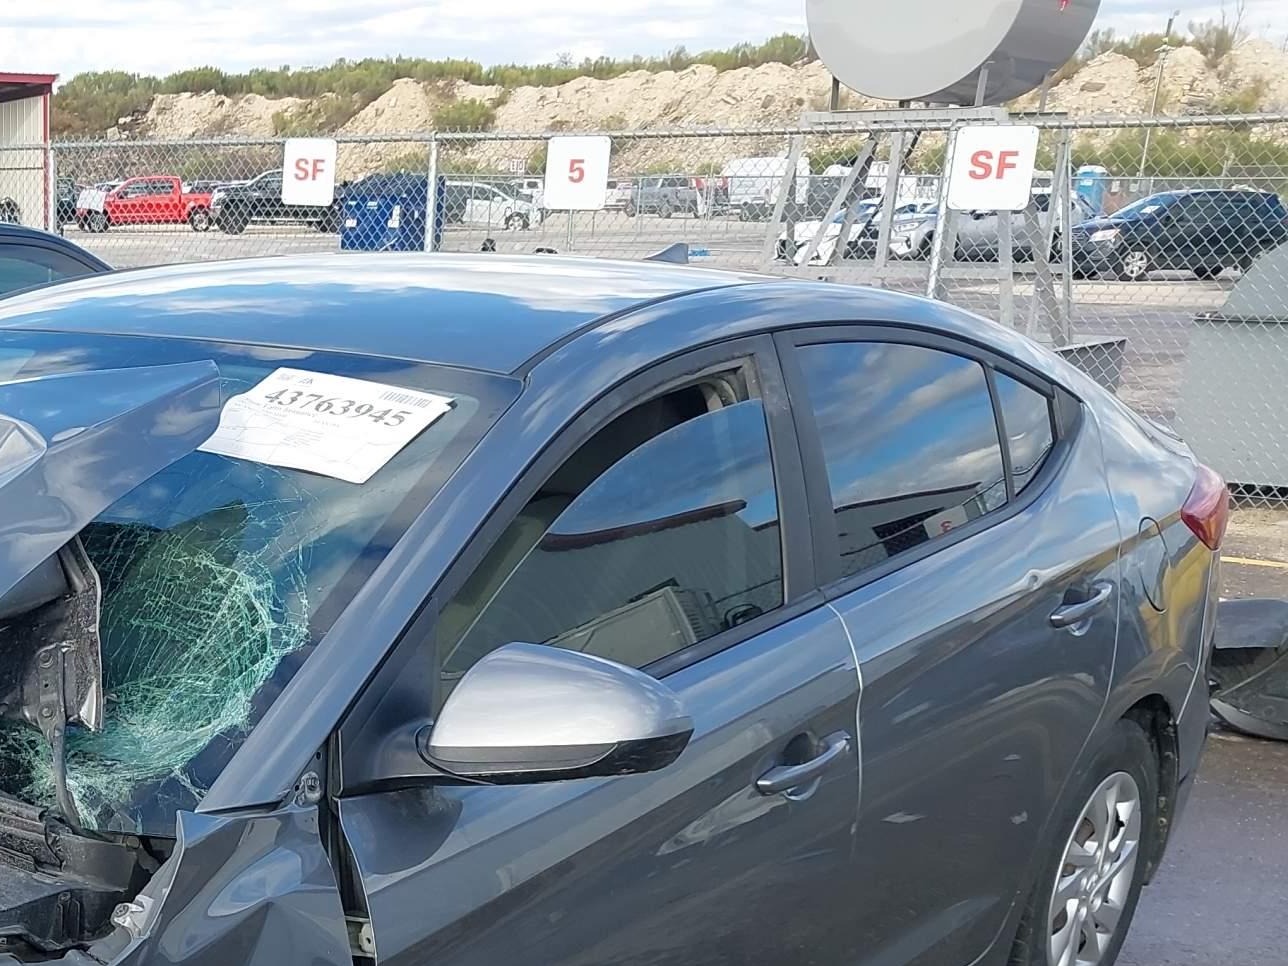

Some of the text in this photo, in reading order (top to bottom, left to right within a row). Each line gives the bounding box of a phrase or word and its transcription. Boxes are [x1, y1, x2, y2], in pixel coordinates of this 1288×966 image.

[294, 158, 326, 181] SF
[568, 158, 585, 184] 5
[968, 150, 1020, 180] SF
[264, 388, 413, 427] 43763945
